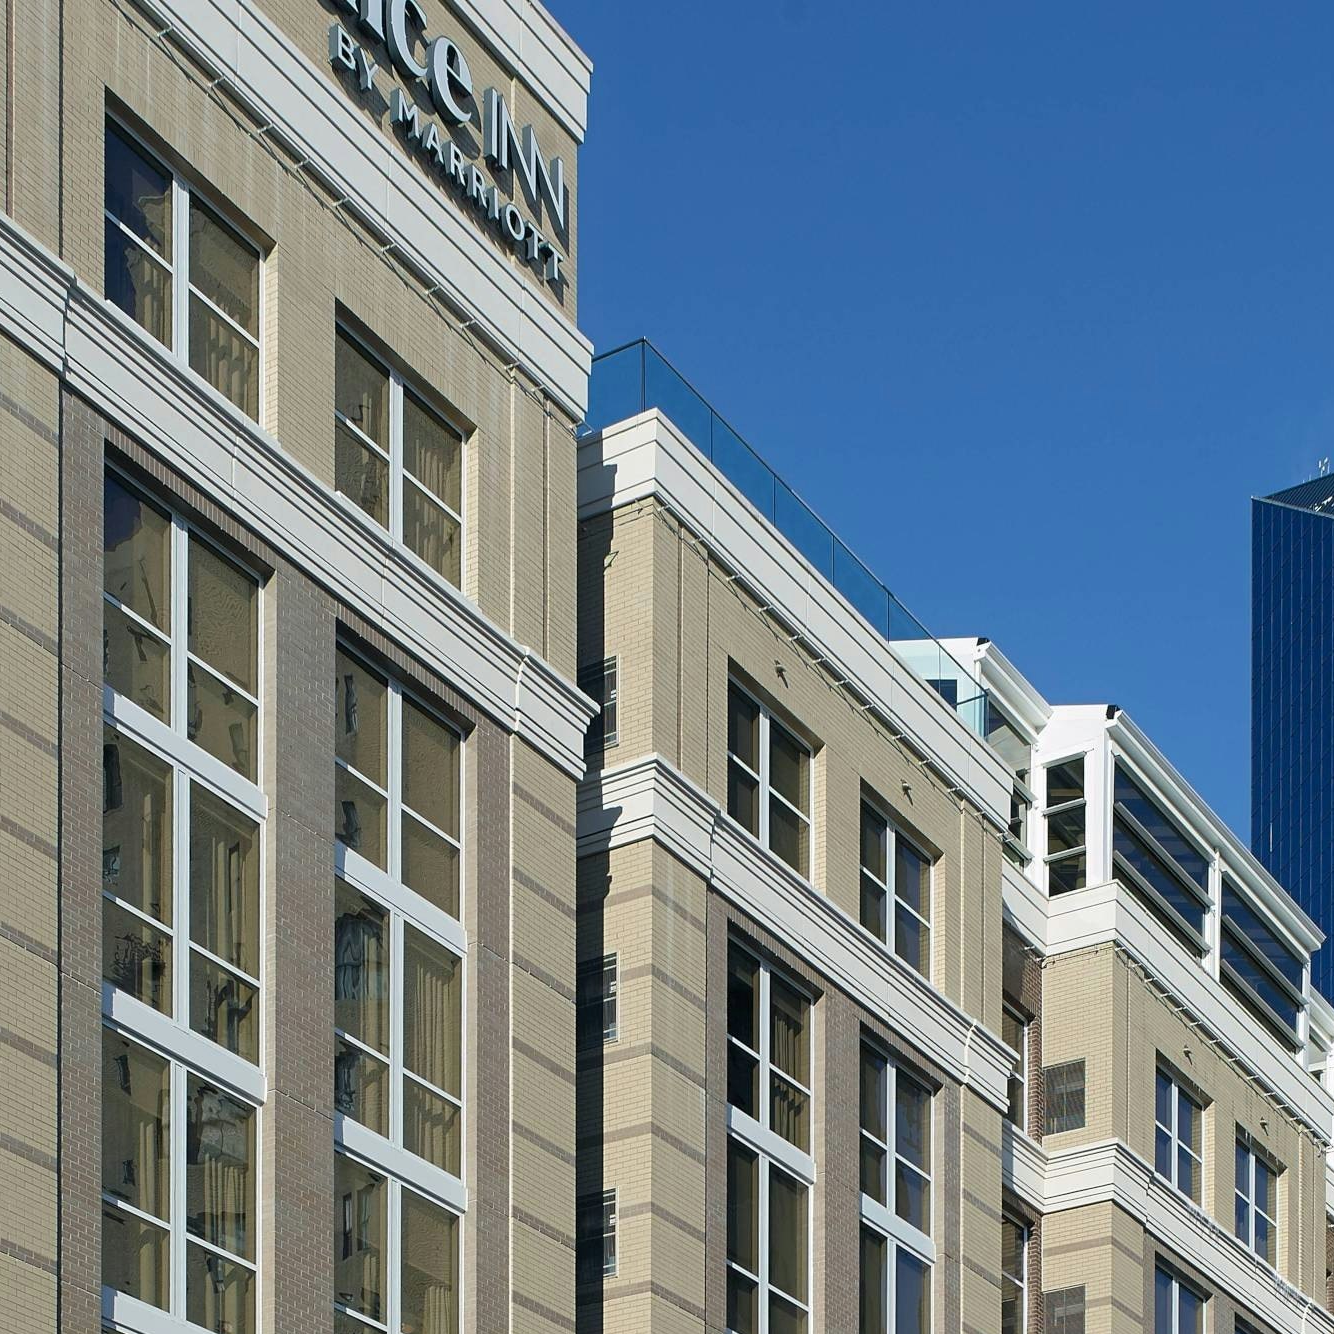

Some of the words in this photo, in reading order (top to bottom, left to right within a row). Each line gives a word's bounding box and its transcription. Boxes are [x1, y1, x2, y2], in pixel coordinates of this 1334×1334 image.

[329, 23, 378, 91] BY
[390, 88, 564, 281] MARRIOTT
[484, 87, 565, 236] INN
